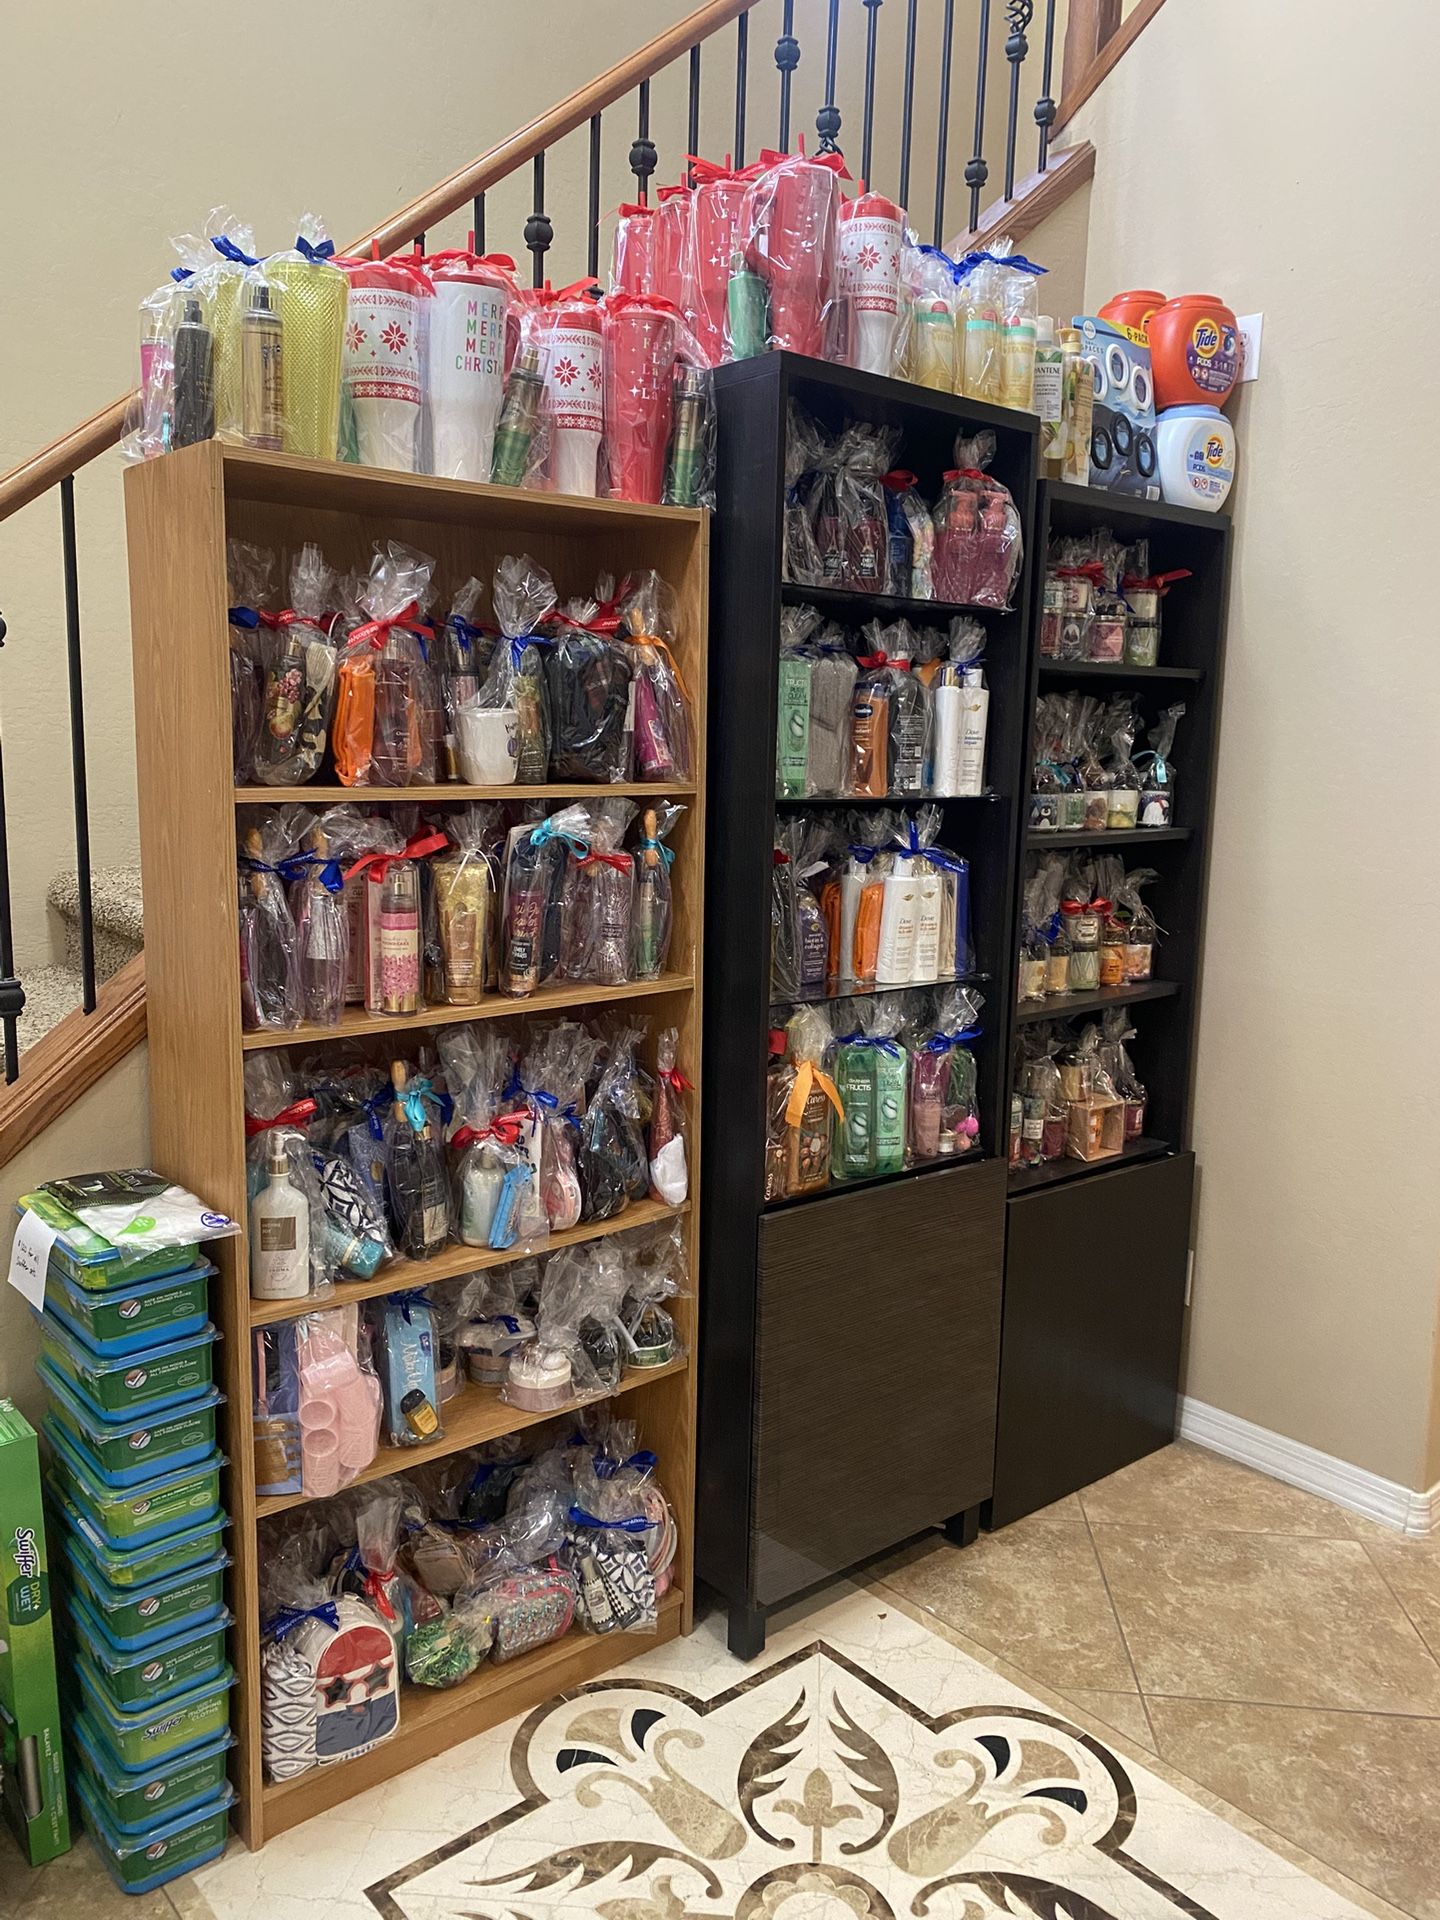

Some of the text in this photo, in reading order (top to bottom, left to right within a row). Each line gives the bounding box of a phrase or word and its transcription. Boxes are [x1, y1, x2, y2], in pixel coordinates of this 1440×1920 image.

[467, 300, 506, 321] MERR
[1195, 328, 1219, 349] Tide
[465, 338, 502, 361] MER
[1206, 441, 1225, 459] Tide
[785, 678, 806, 688] FRUCT
[846, 1083, 872, 1092] FRUCTIS
[806, 1095, 826, 1105] Caress
[764, 1172, 774, 1201] Caress
[13, 1526, 35, 1577] Swiffer
[20, 1585, 31, 1612] WET
[187, 1699, 222, 1719] MOPPING
[191, 1706, 219, 1722] CLOTHS
[143, 1716, 185, 1738] Swiffer
